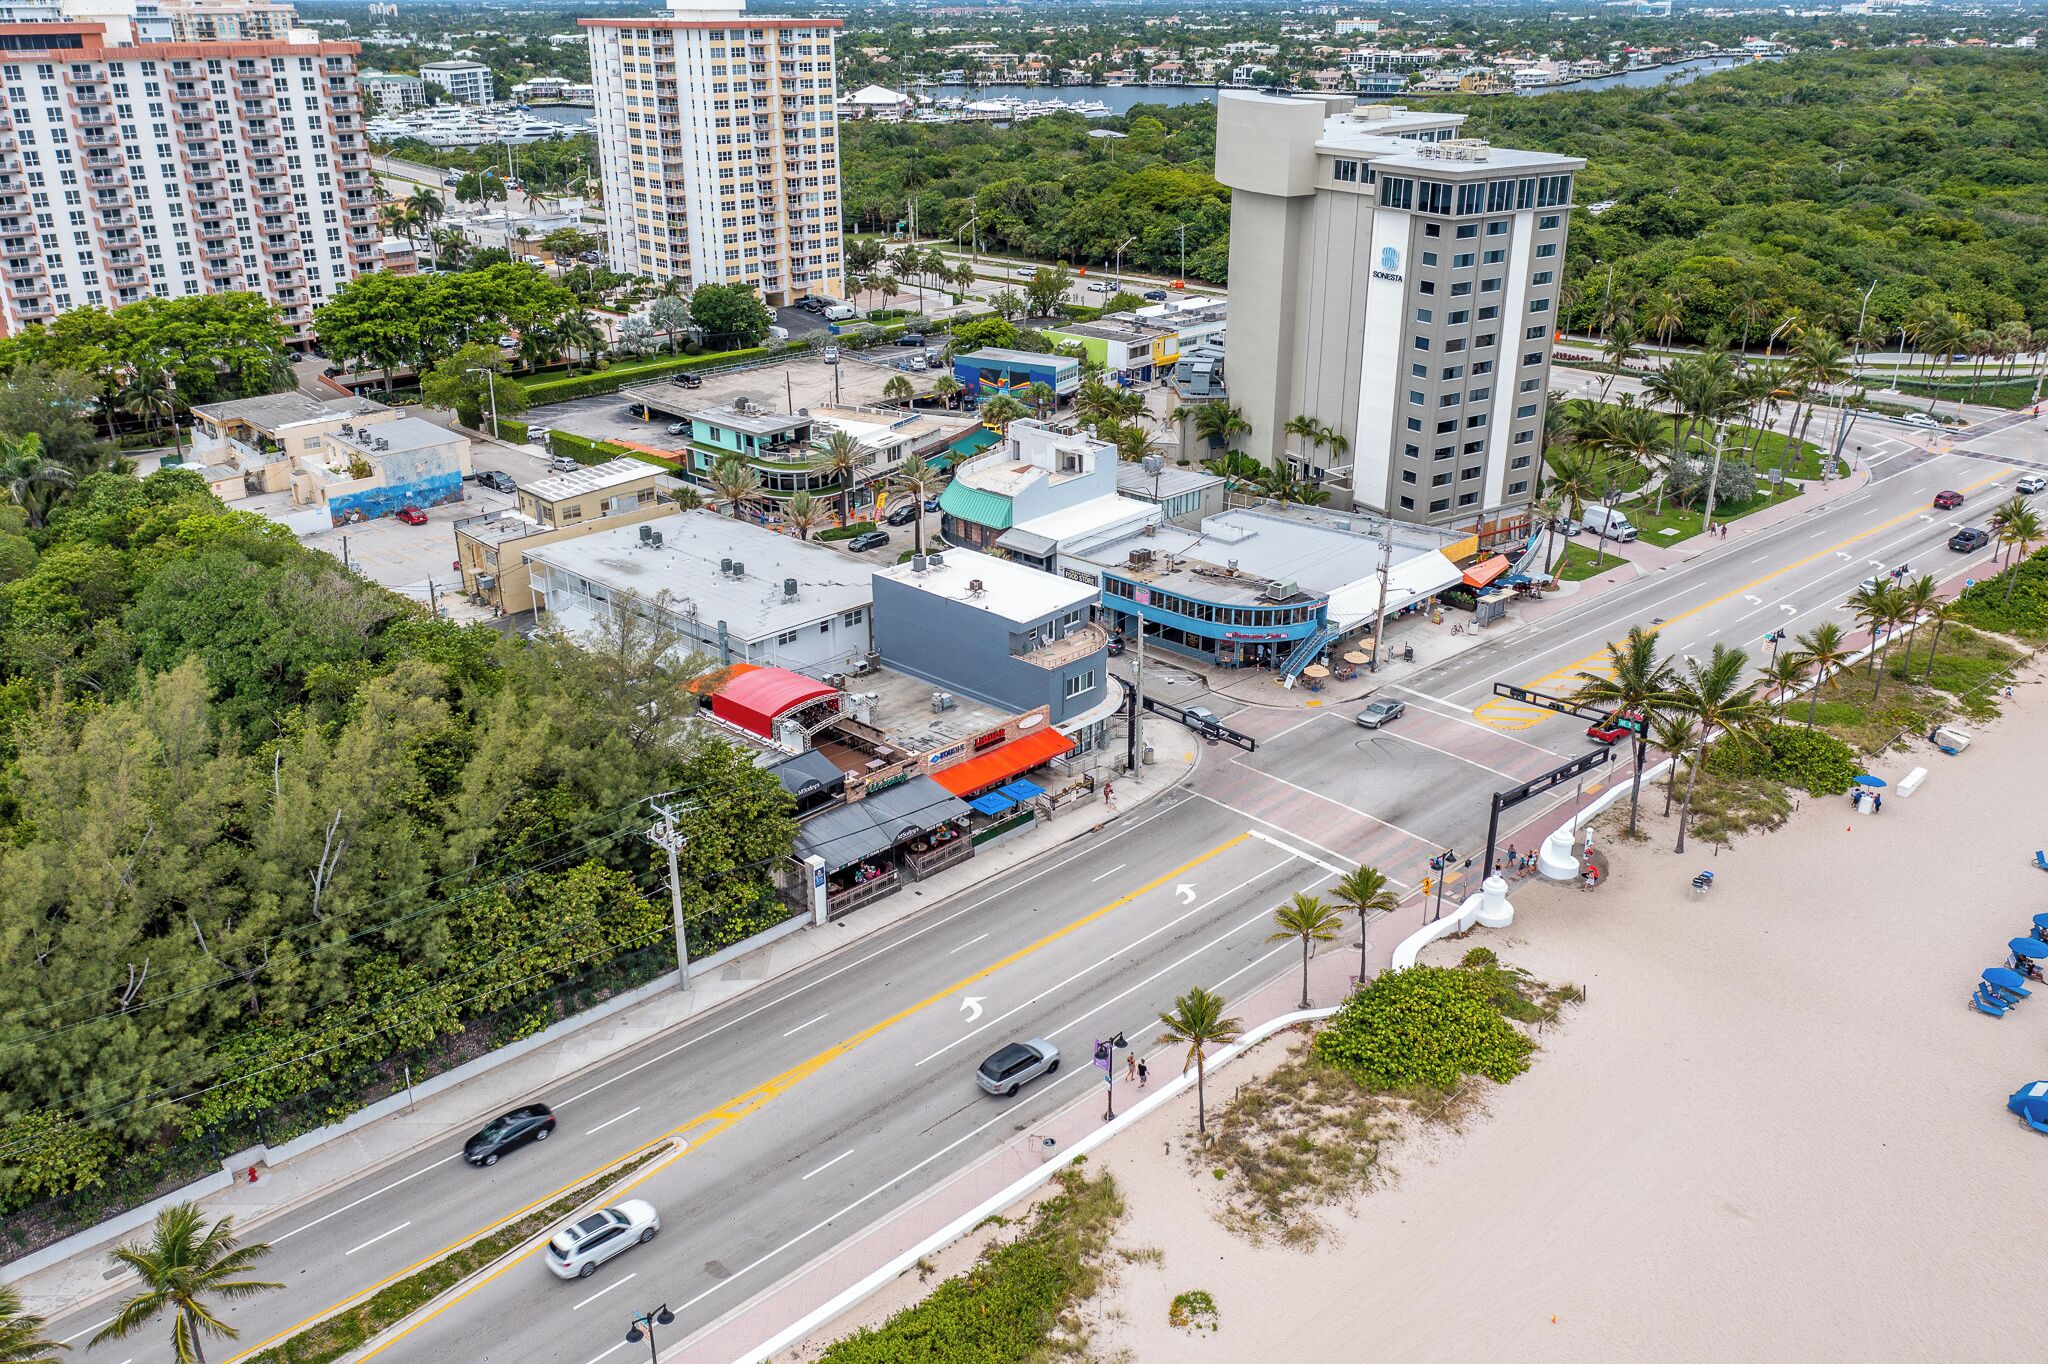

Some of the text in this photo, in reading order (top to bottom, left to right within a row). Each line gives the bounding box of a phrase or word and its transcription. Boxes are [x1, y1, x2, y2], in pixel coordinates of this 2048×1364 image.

[1372, 270, 1403, 283] SONESTA
[1065, 571, 1079, 581] FOOD
[1079, 575, 1095, 586] STORE
[975, 728, 1006, 747] LIQUOR
